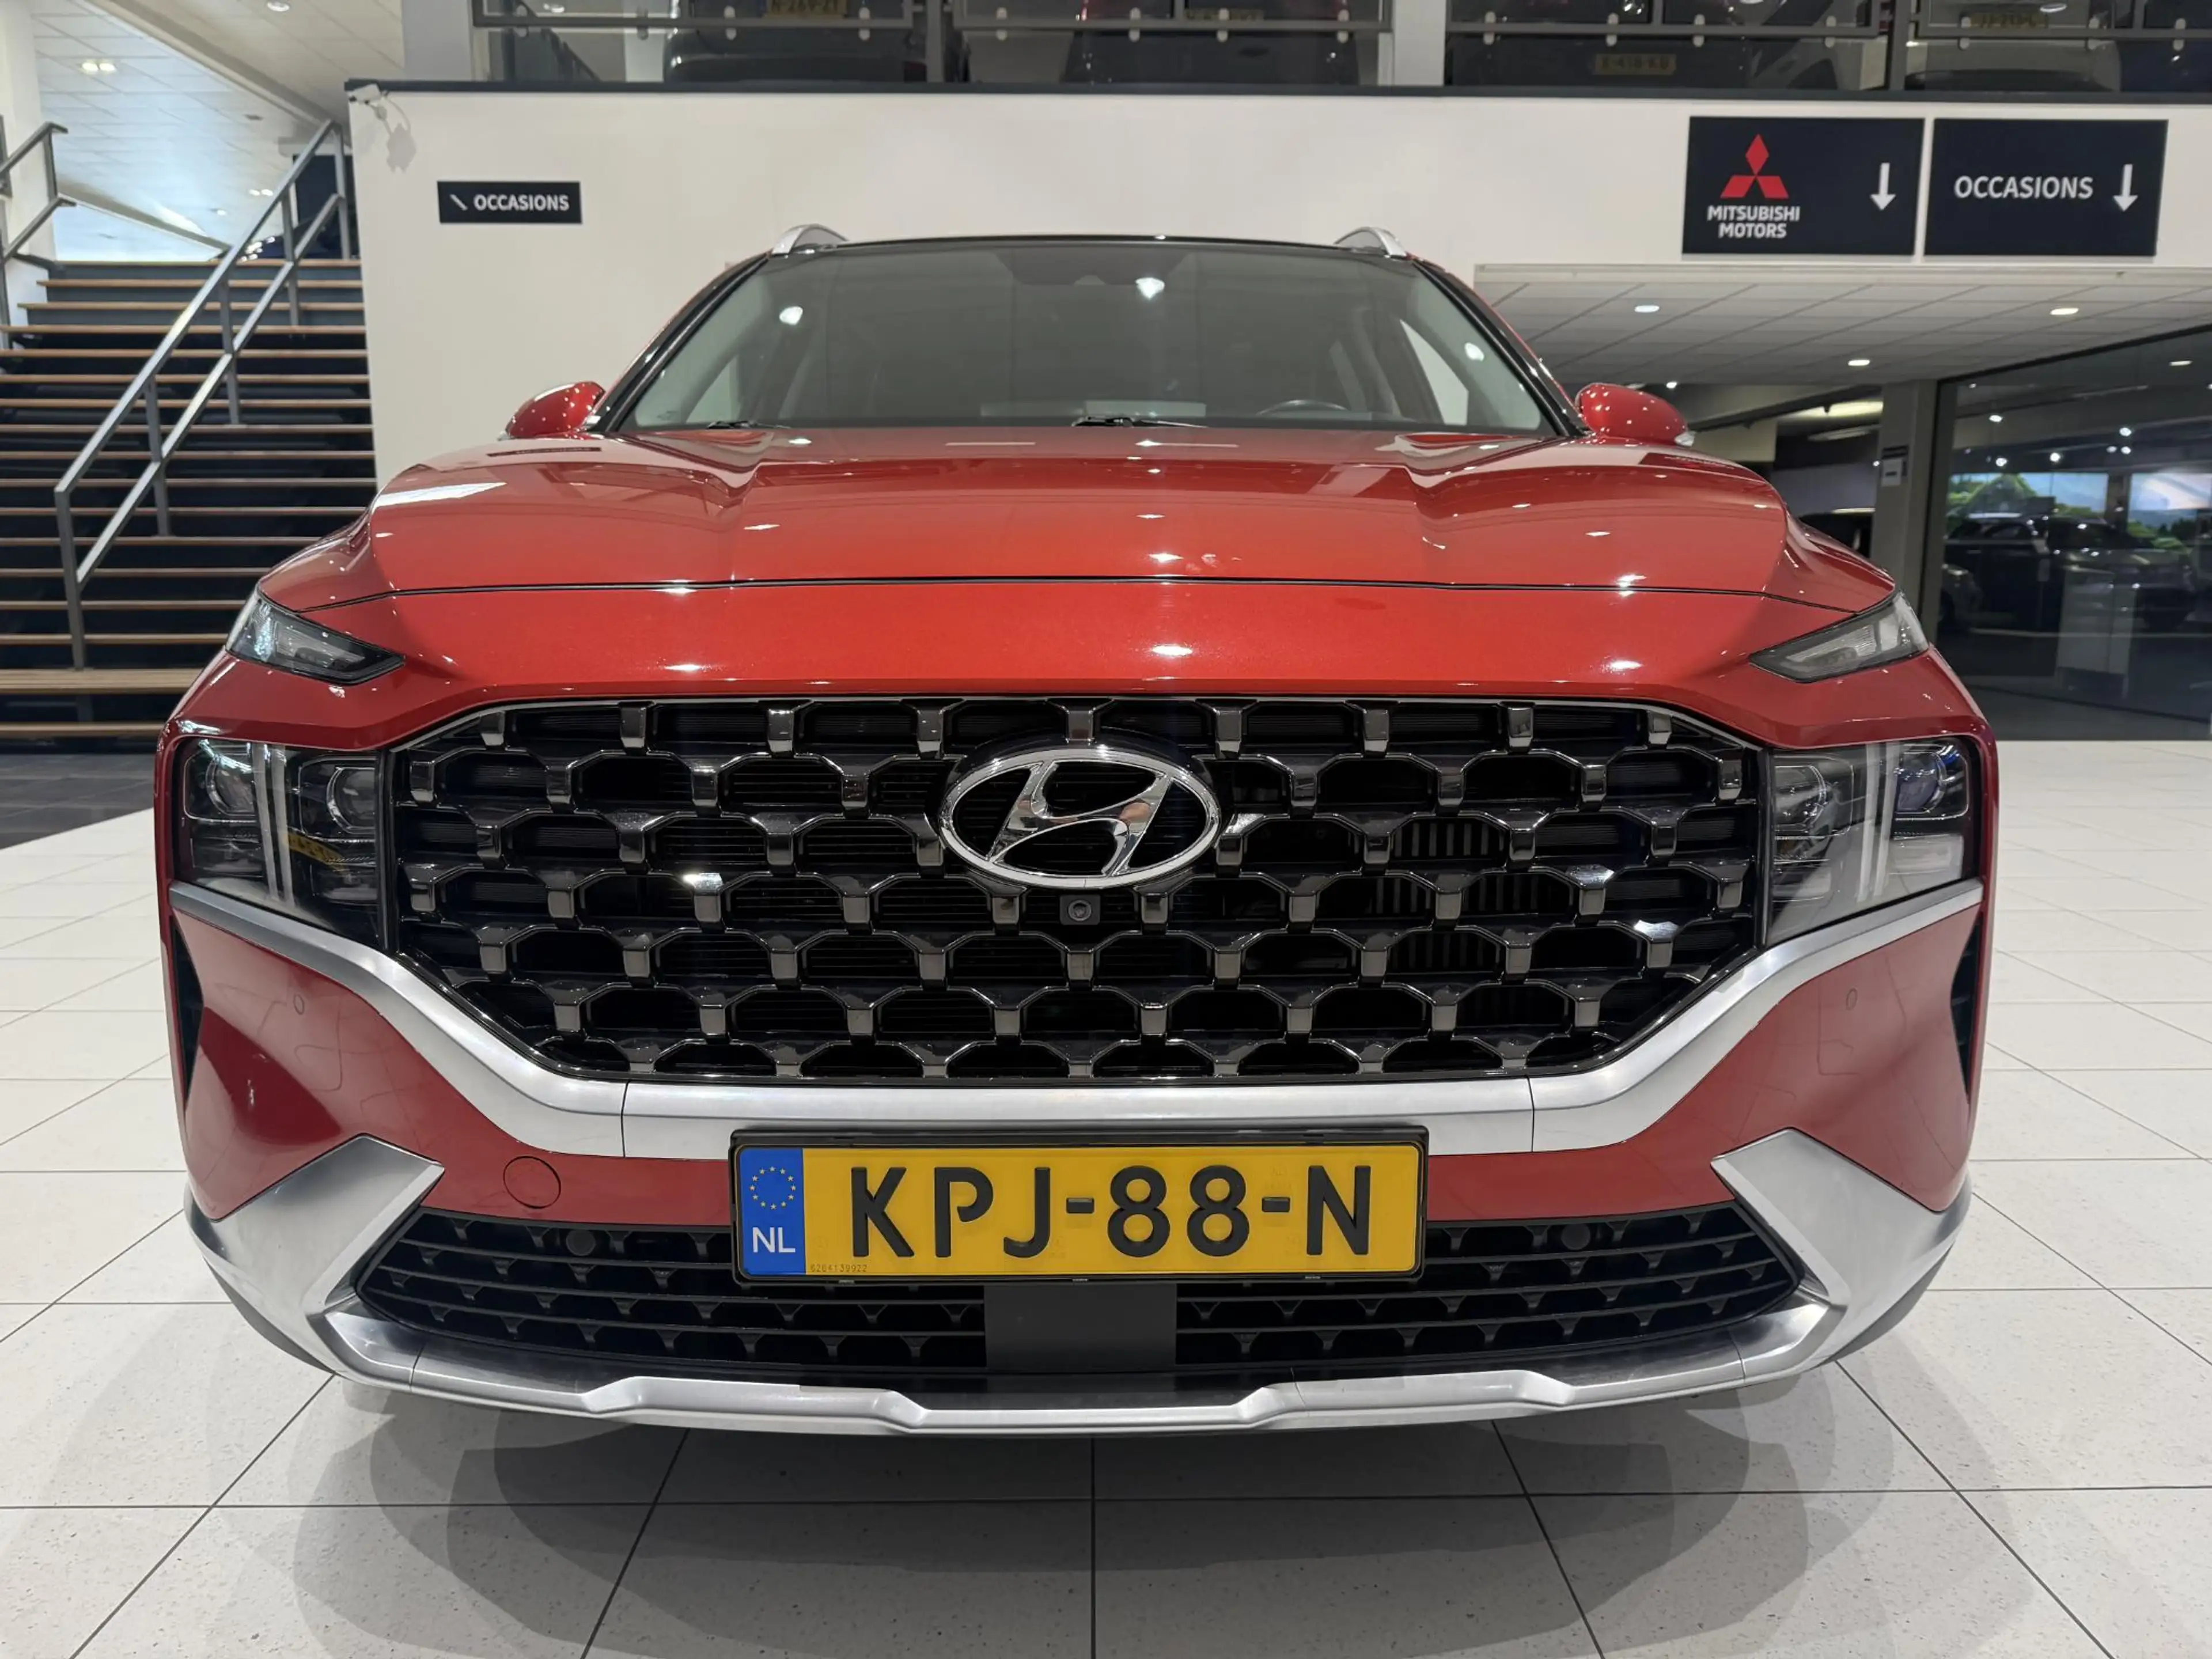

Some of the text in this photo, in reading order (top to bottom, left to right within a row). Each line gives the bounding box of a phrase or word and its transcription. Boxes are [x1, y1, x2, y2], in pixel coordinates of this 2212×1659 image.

[1953, 175, 2093, 199] OCCASIONS
[474, 194, 570, 211] OCCASIONS
[1707, 204, 1800, 222] MITSUBISHI
[1718, 222, 1787, 239] MOTORS
[850, 1165, 1372, 1259] KPJ-88-N
[752, 1227, 796, 1253] NL
